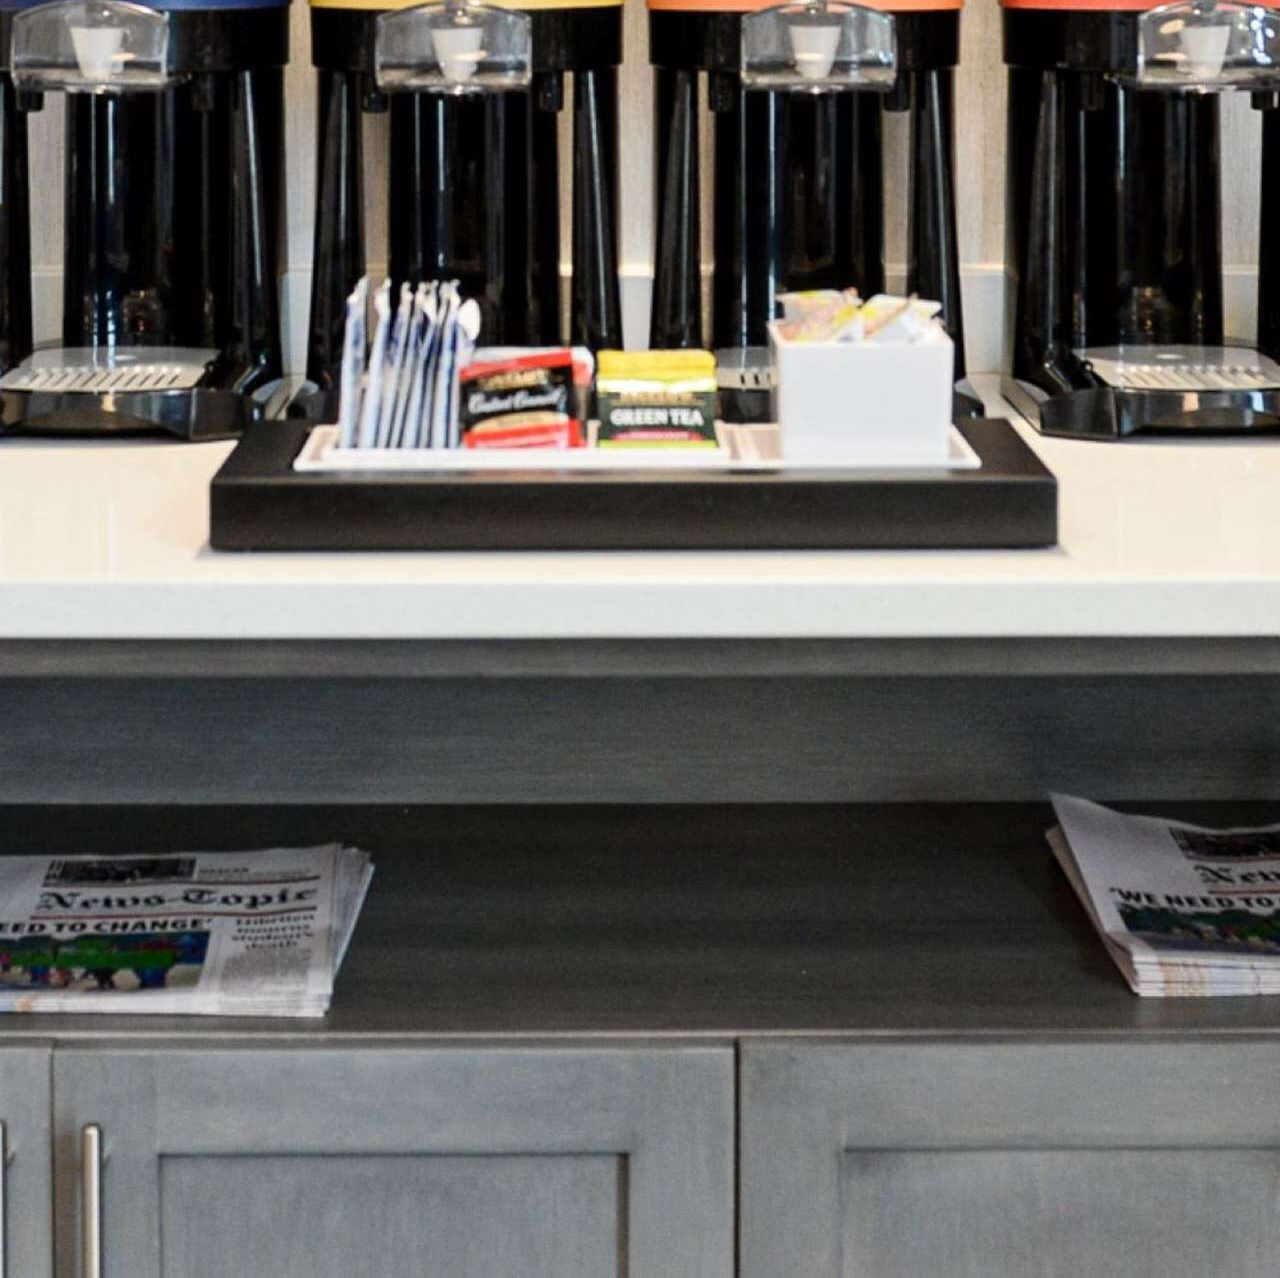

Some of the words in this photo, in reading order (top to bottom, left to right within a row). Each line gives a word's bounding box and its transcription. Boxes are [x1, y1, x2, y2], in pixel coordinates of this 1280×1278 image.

[610, 408, 668, 426] GREEN
[669, 408, 704, 426] TEA
[1168, 894, 1234, 909] NEED
[1241, 896, 1274, 909] TO
[51, 922, 88, 933] TO
